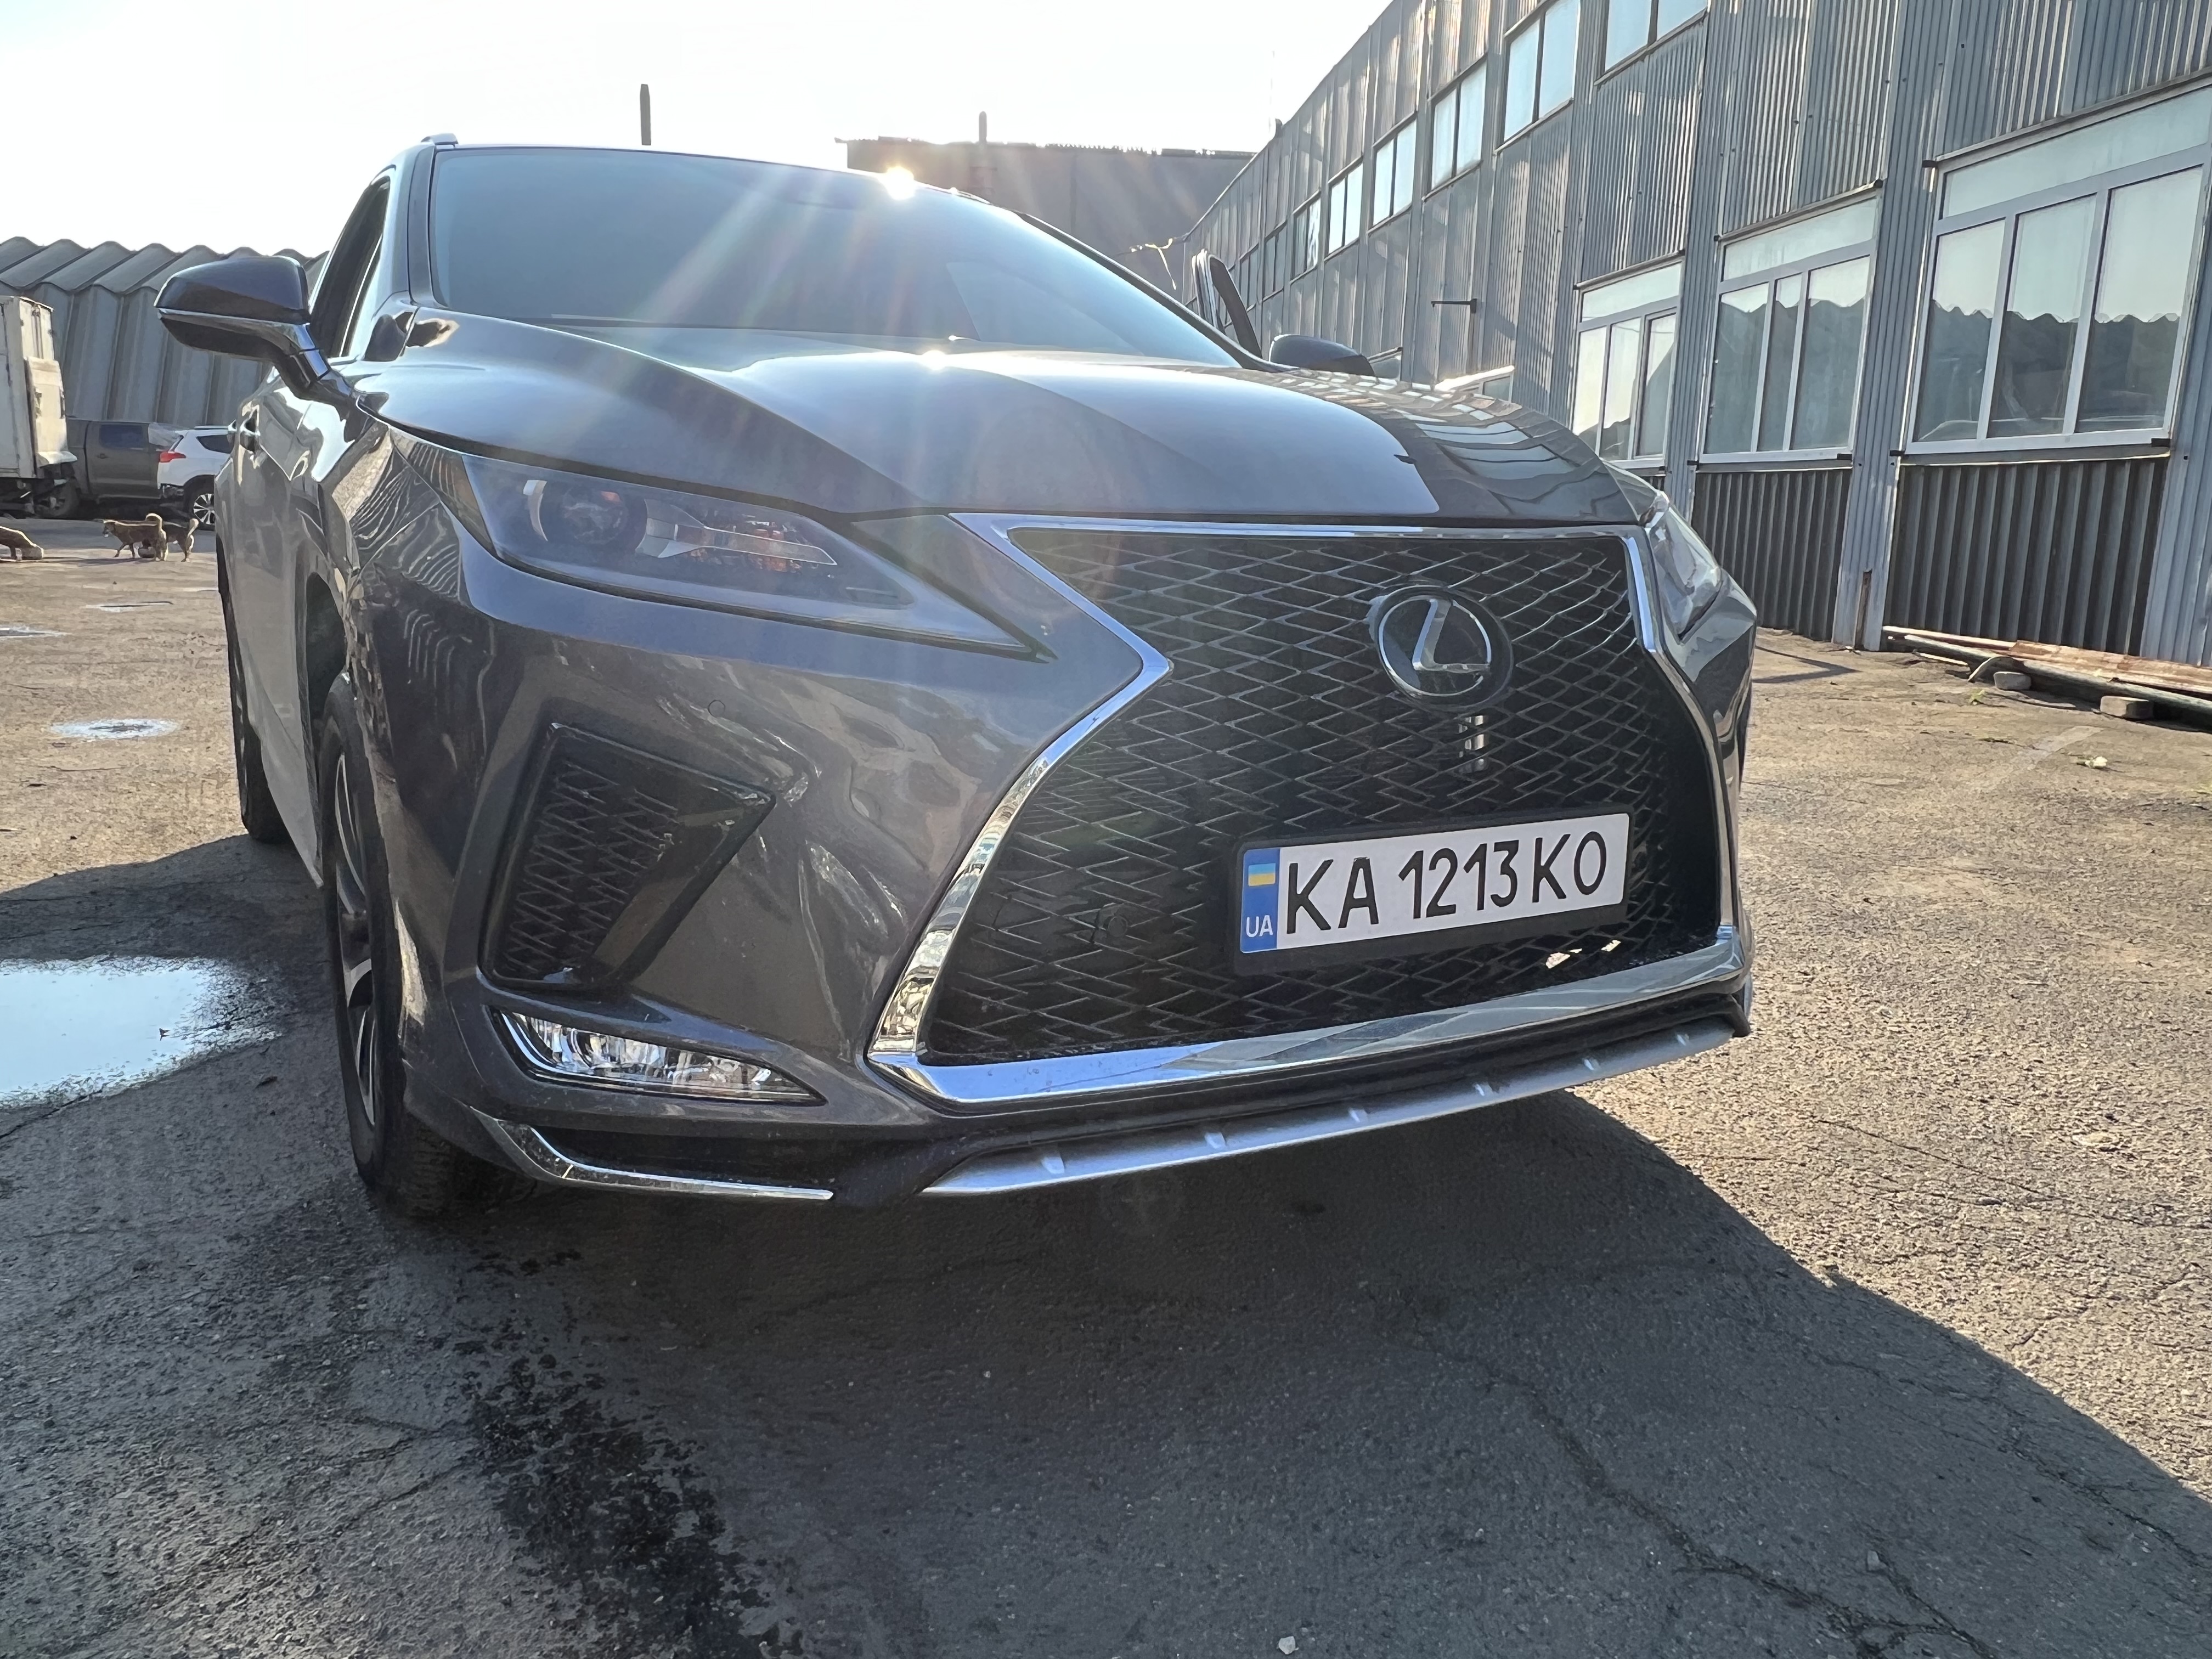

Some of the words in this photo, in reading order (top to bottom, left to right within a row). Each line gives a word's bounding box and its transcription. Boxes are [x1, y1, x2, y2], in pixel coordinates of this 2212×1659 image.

[1286, 856, 1379, 934] KA
[1398, 839, 1519, 919] 1213
[1532, 831, 1607, 904] KO
[1245, 915, 1274, 938] UA
